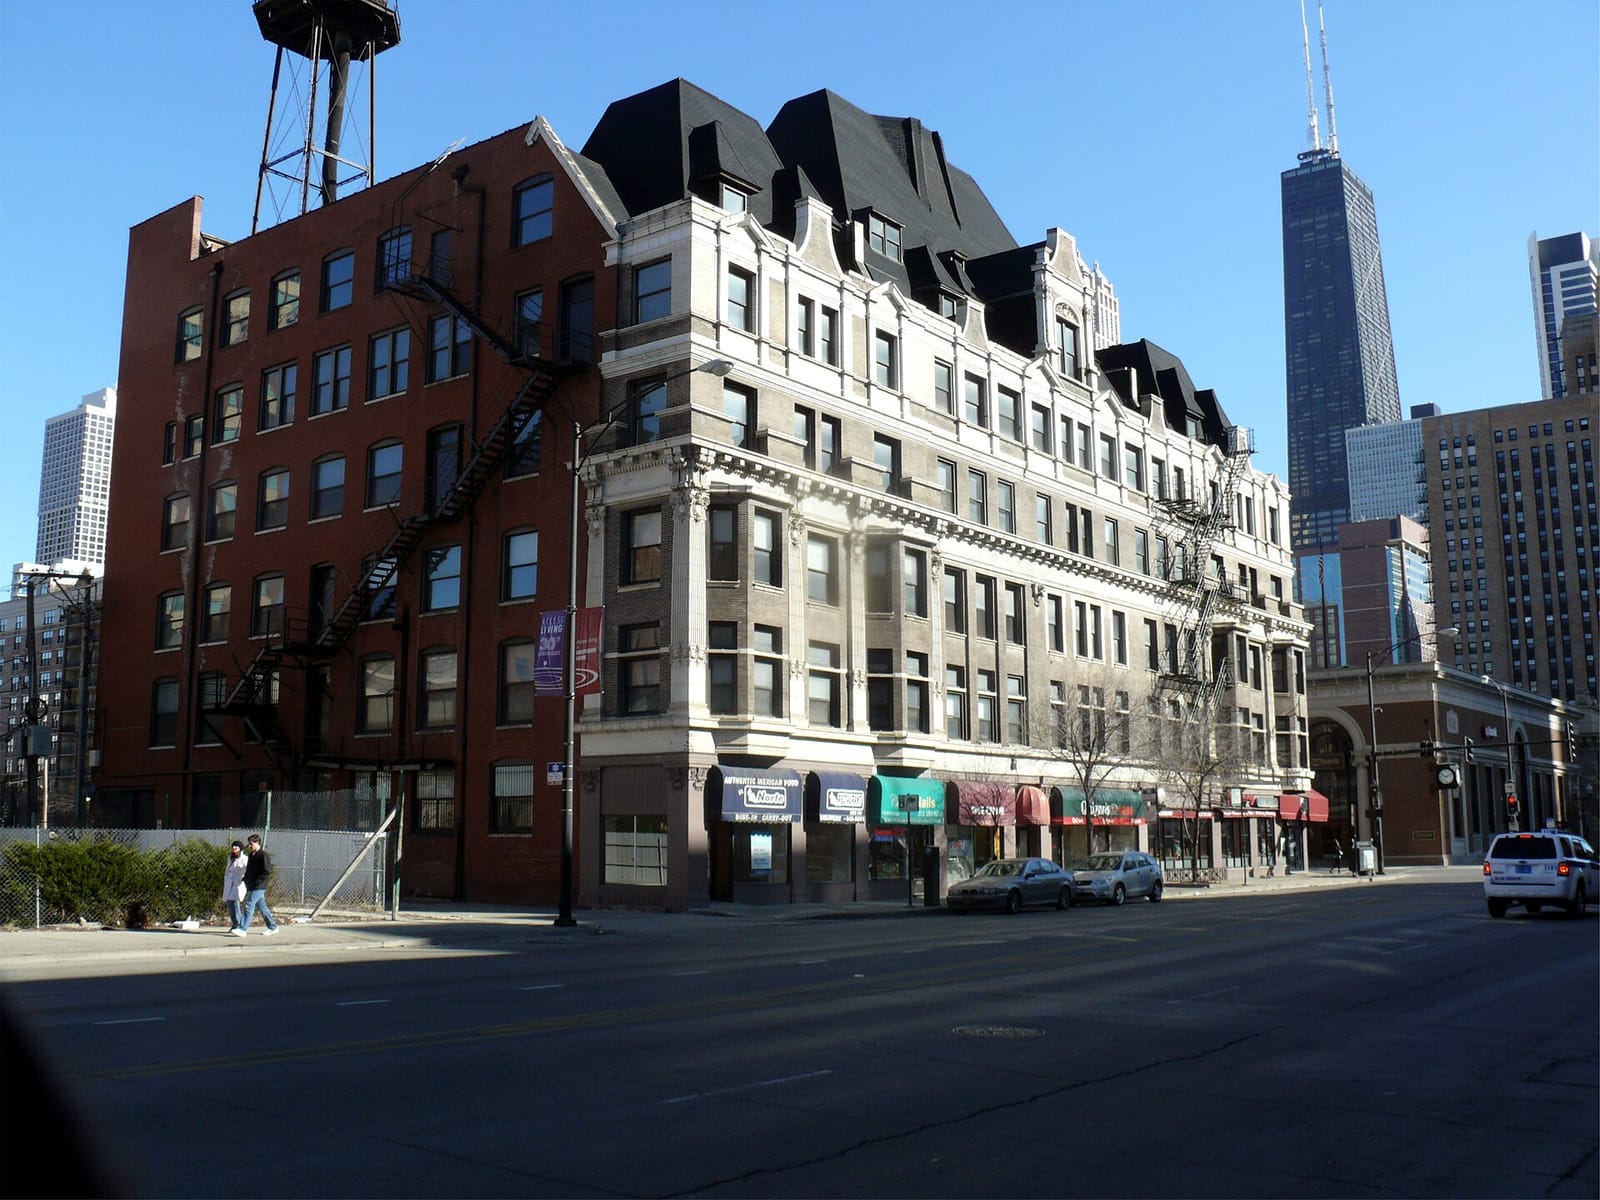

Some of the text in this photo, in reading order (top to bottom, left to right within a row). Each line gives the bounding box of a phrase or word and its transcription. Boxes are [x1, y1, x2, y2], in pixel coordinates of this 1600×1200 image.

[540, 624, 563, 634] LIVING
[724, 776, 799, 787] AUTHENTIC MEXICAN FOOD
